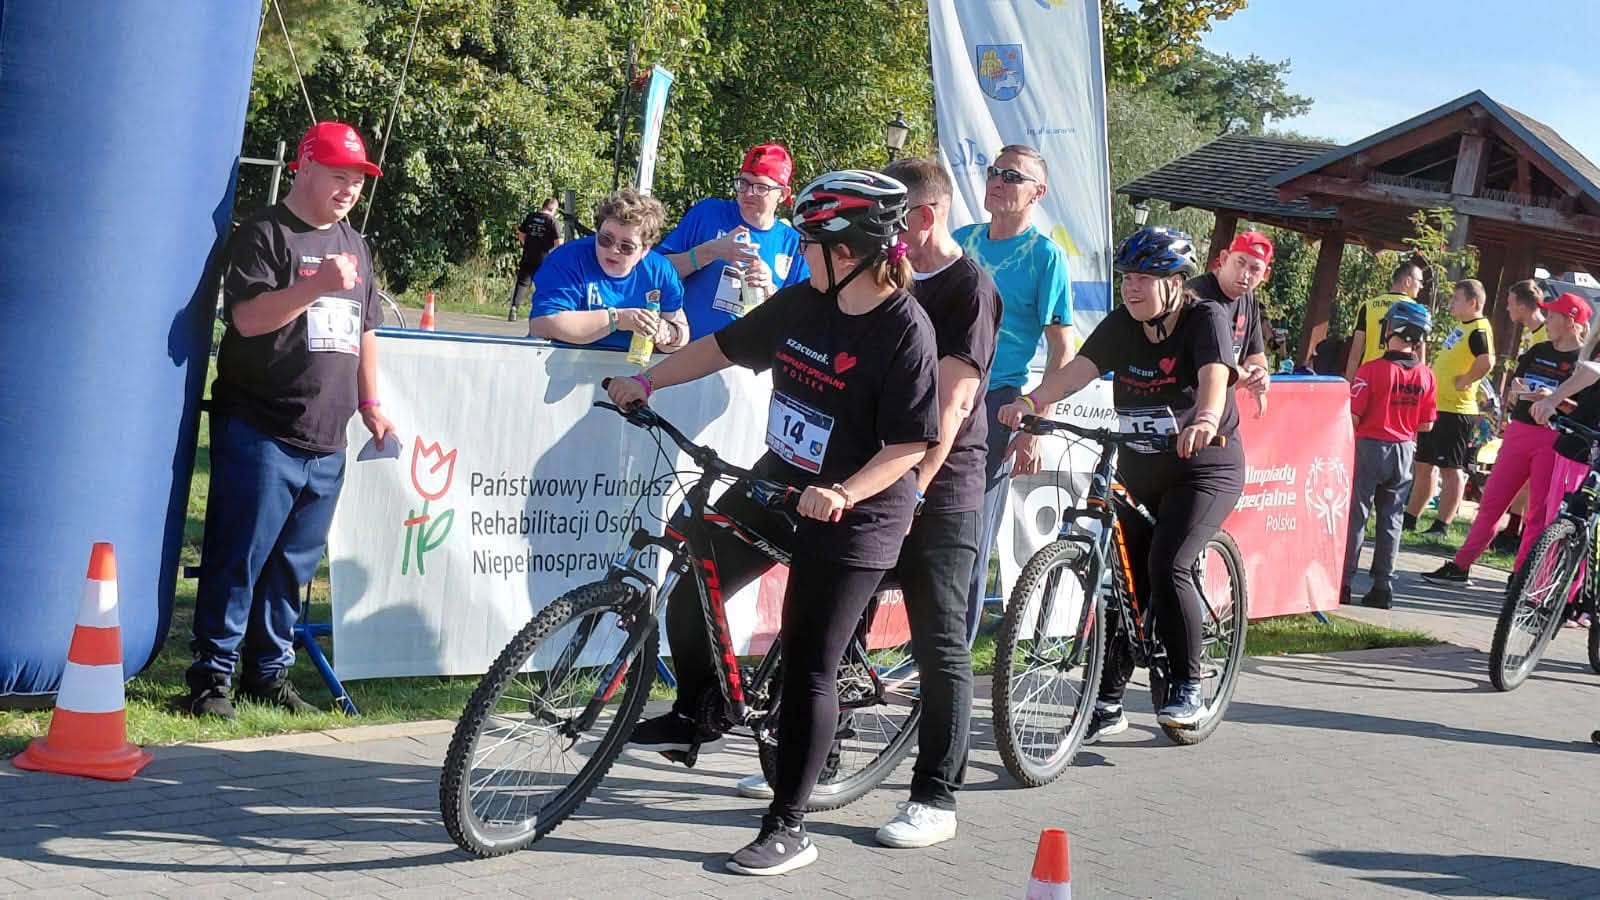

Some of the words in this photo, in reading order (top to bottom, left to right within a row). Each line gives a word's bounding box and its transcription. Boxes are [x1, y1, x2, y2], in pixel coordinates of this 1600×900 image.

[786, 338, 829, 365] szacunek.
[1055, 402, 1071, 416] ER
[783, 415, 806, 445] 14
[1131, 420, 1158, 435] 15
[470, 471, 588, 504] Państwowy
[592, 472, 673, 497] Fundusz
[1245, 464, 1297, 486] limpiady
[471, 509, 589, 541] Rehabilitacji
[1265, 512, 1297, 532] Polska
[473, 545, 658, 581] Niepełnosprawch
